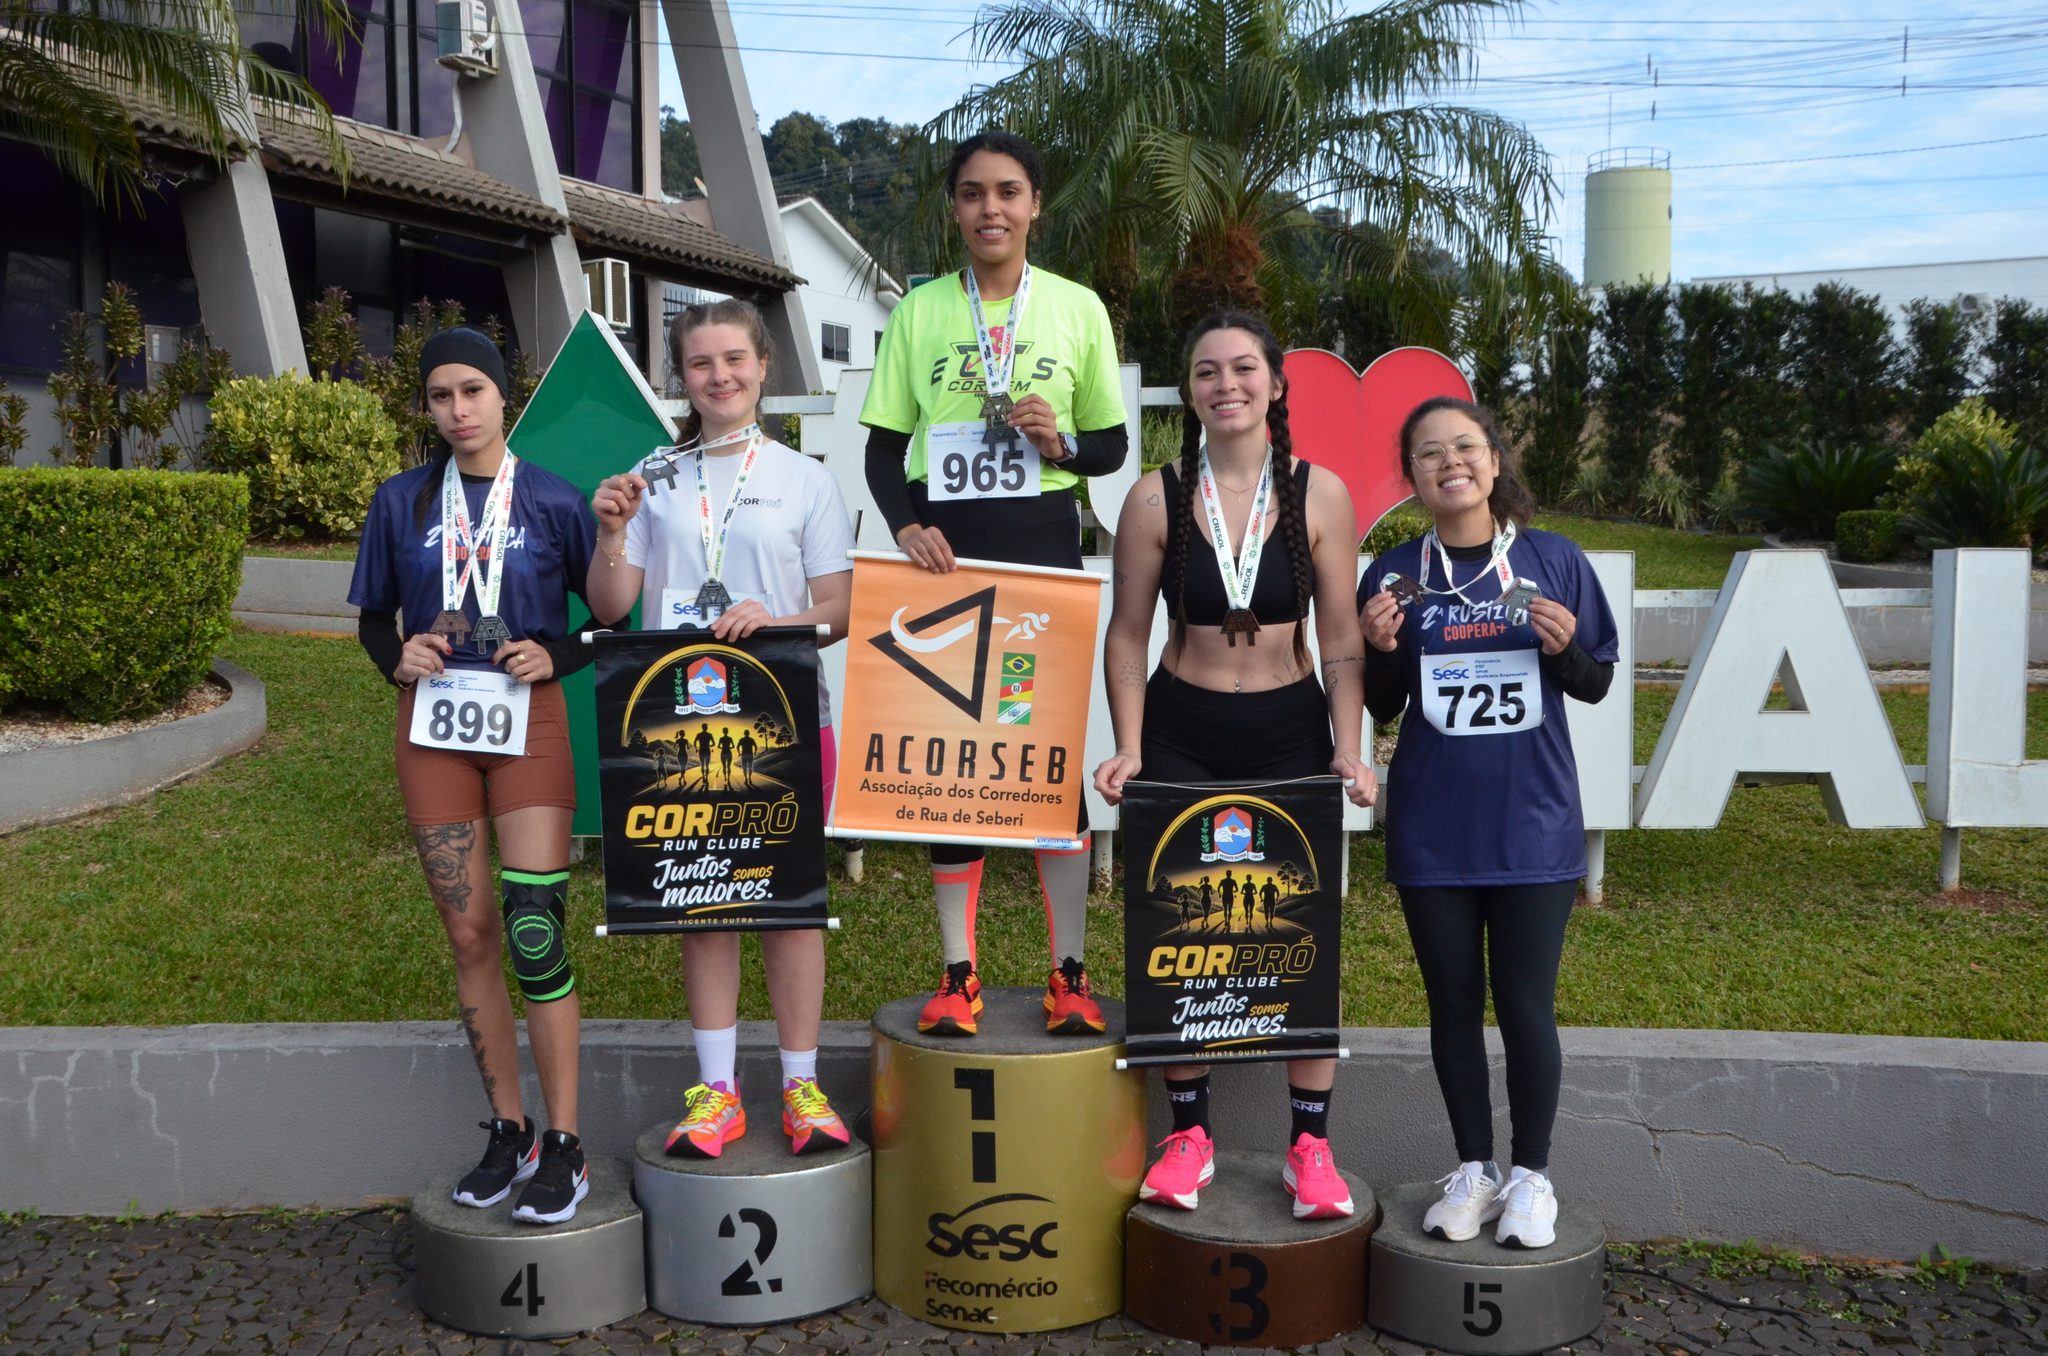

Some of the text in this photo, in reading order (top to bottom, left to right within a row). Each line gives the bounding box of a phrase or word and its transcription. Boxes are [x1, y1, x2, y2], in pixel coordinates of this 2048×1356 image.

[943, 450, 1026, 494] 965
[496, 530, 505, 562] CRESOL
[1212, 517, 1225, 551] CRESOL
[673, 602, 701, 615] Ses
[429, 699, 512, 746] 899
[1438, 682, 1525, 728] 725
[864, 733, 1067, 785] ACORSEB
[859, 778, 1062, 805] Associação dos Corredores
[625, 792, 798, 839] CORPRÓ
[896, 805, 1024, 827] de Rua de Seberi
[663, 837, 762, 851] RUN CLUBE
[652, 853, 774, 889] Juntos somos
[661, 878, 773, 907] maiores.
[1147, 935, 1317, 978] CORPRÓ
[1184, 976, 1279, 990] RUN CLUBE
[1172, 991, 1290, 1025] Juntos somos
[1180, 1013, 1288, 1042] maiores.
[954, 1068, 996, 1183] 1
[718, 1207, 783, 1297] 2
[926, 1212, 1058, 1262] Sesc
[501, 1263, 545, 1316] 4
[1208, 1252, 1270, 1341] 3
[926, 1299, 994, 1324] Senac
[1462, 1282, 1502, 1337] 5
